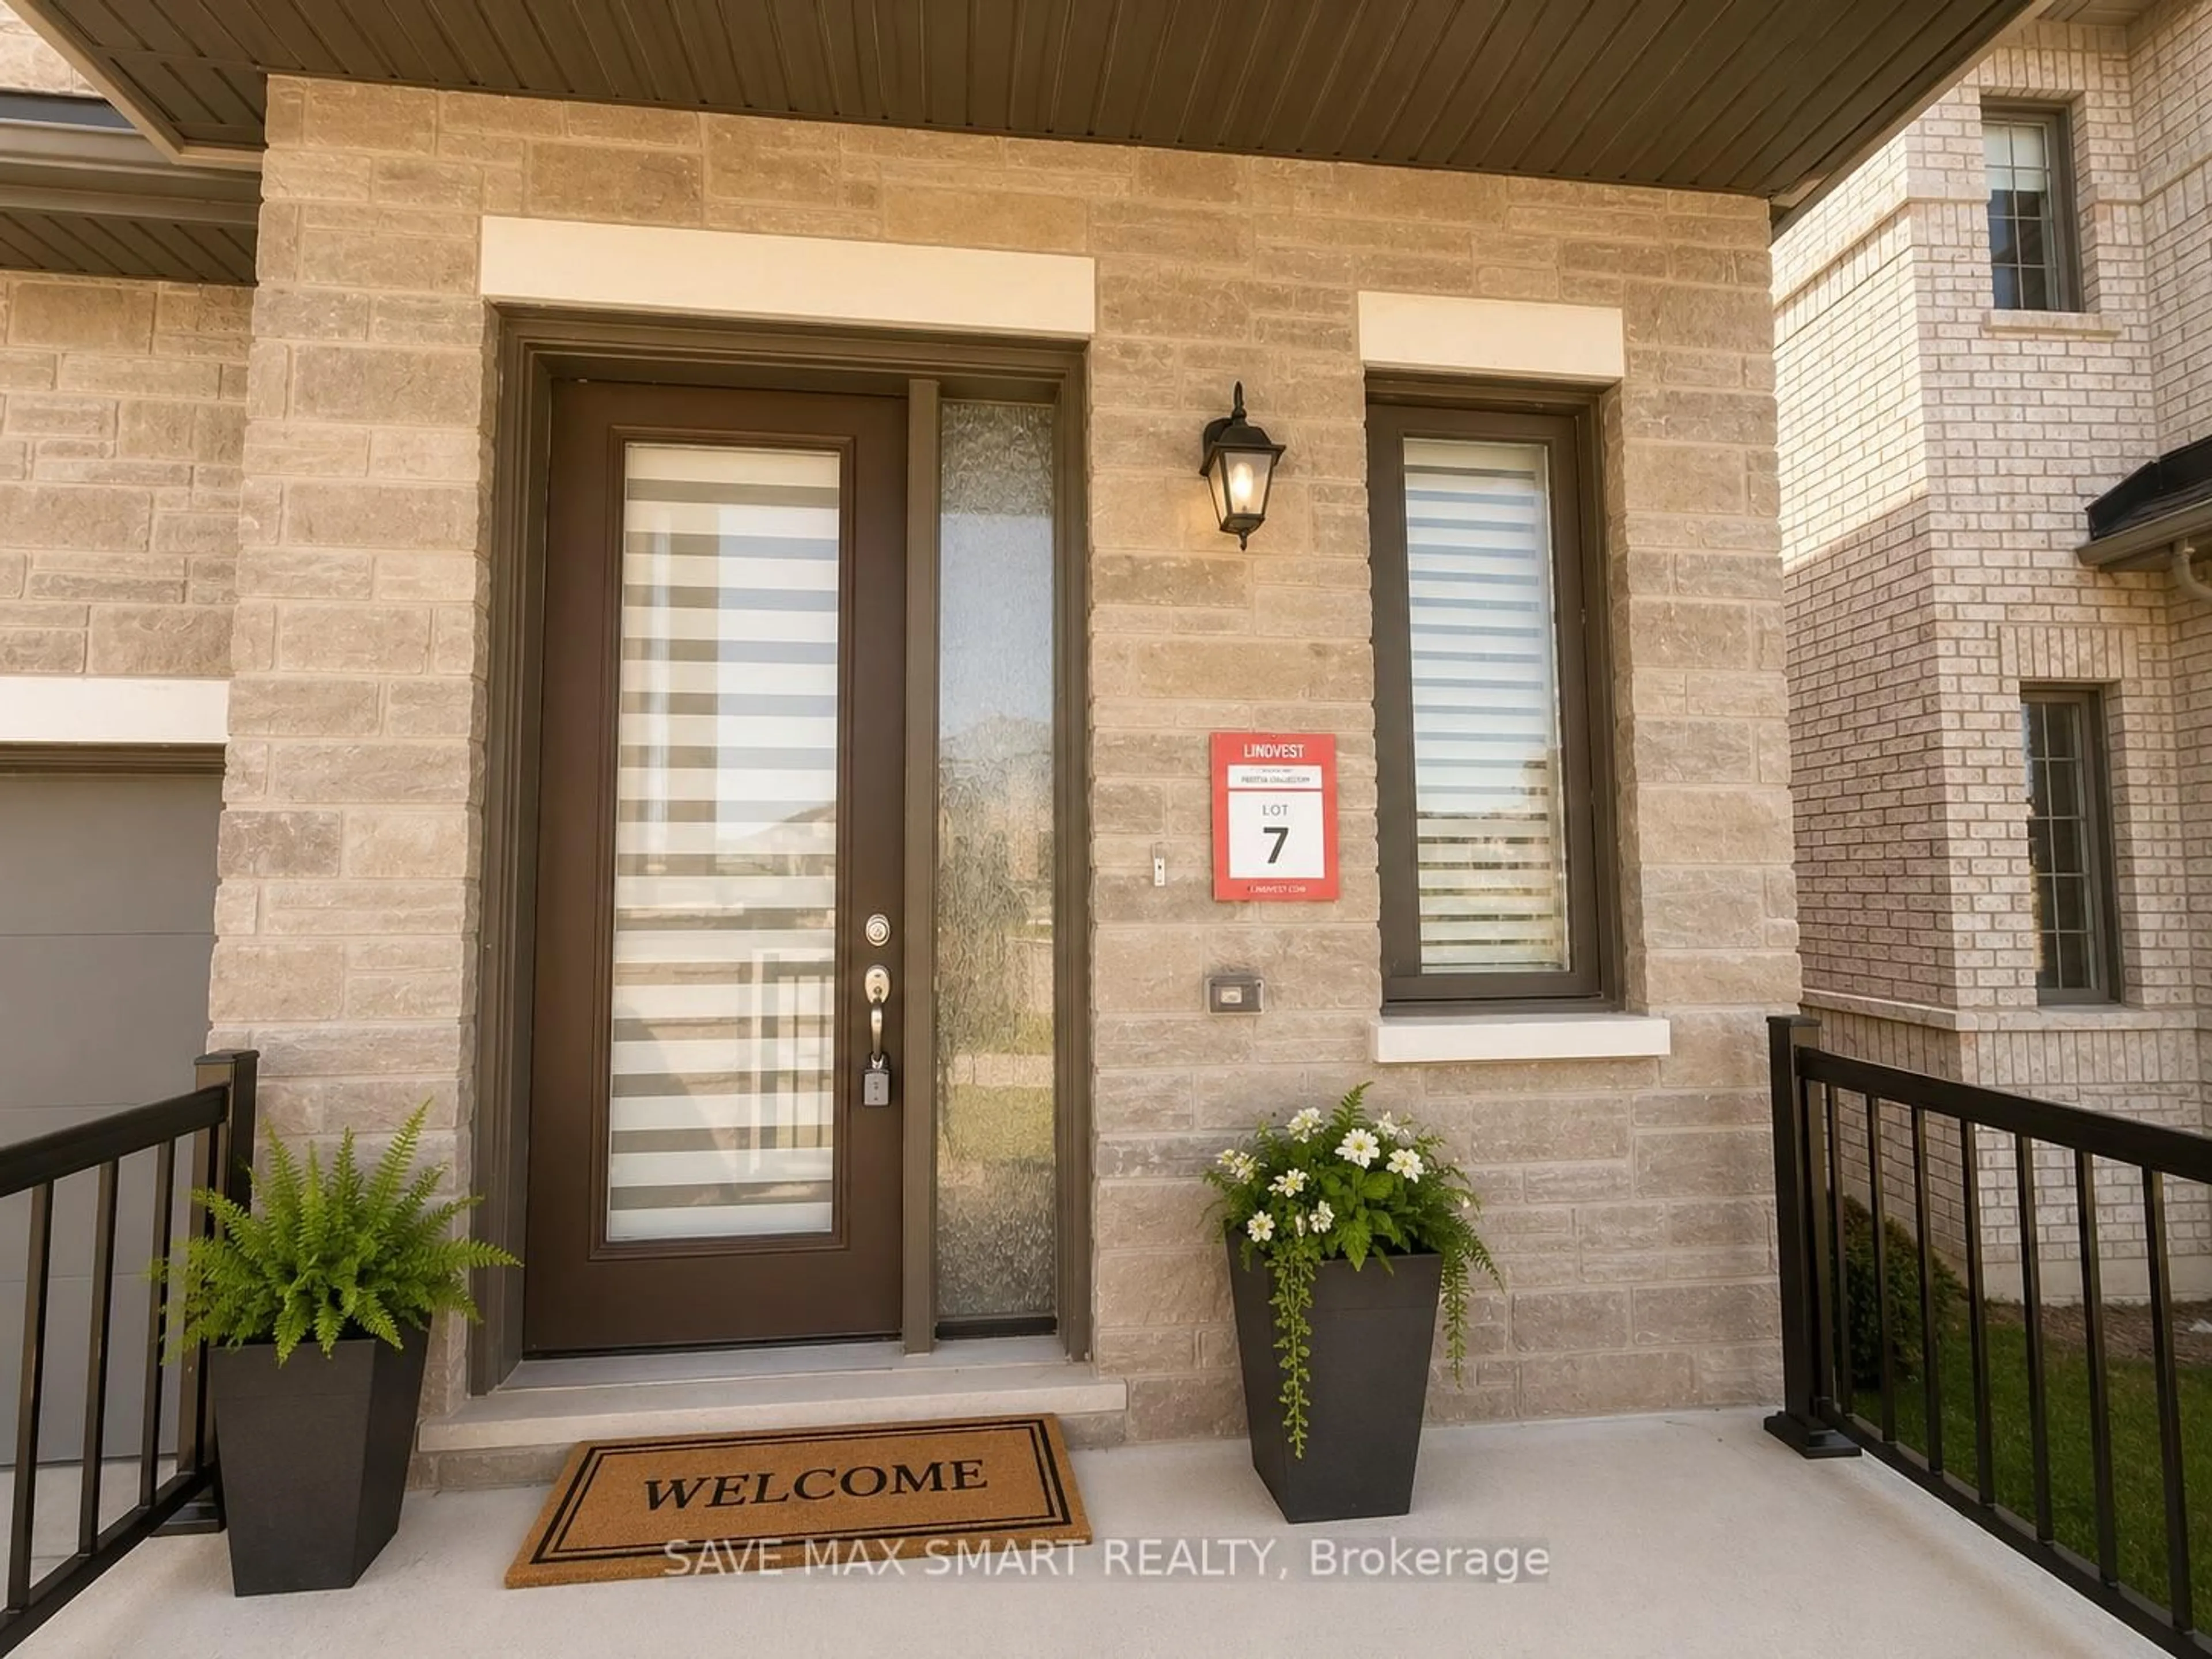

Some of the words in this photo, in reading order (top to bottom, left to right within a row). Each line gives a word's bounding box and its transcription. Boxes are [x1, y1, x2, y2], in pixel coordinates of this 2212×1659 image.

[1262, 805, 1289, 816] LOT
[1263, 827, 1289, 864] 7
[644, 1459, 988, 1511] WELCOME
